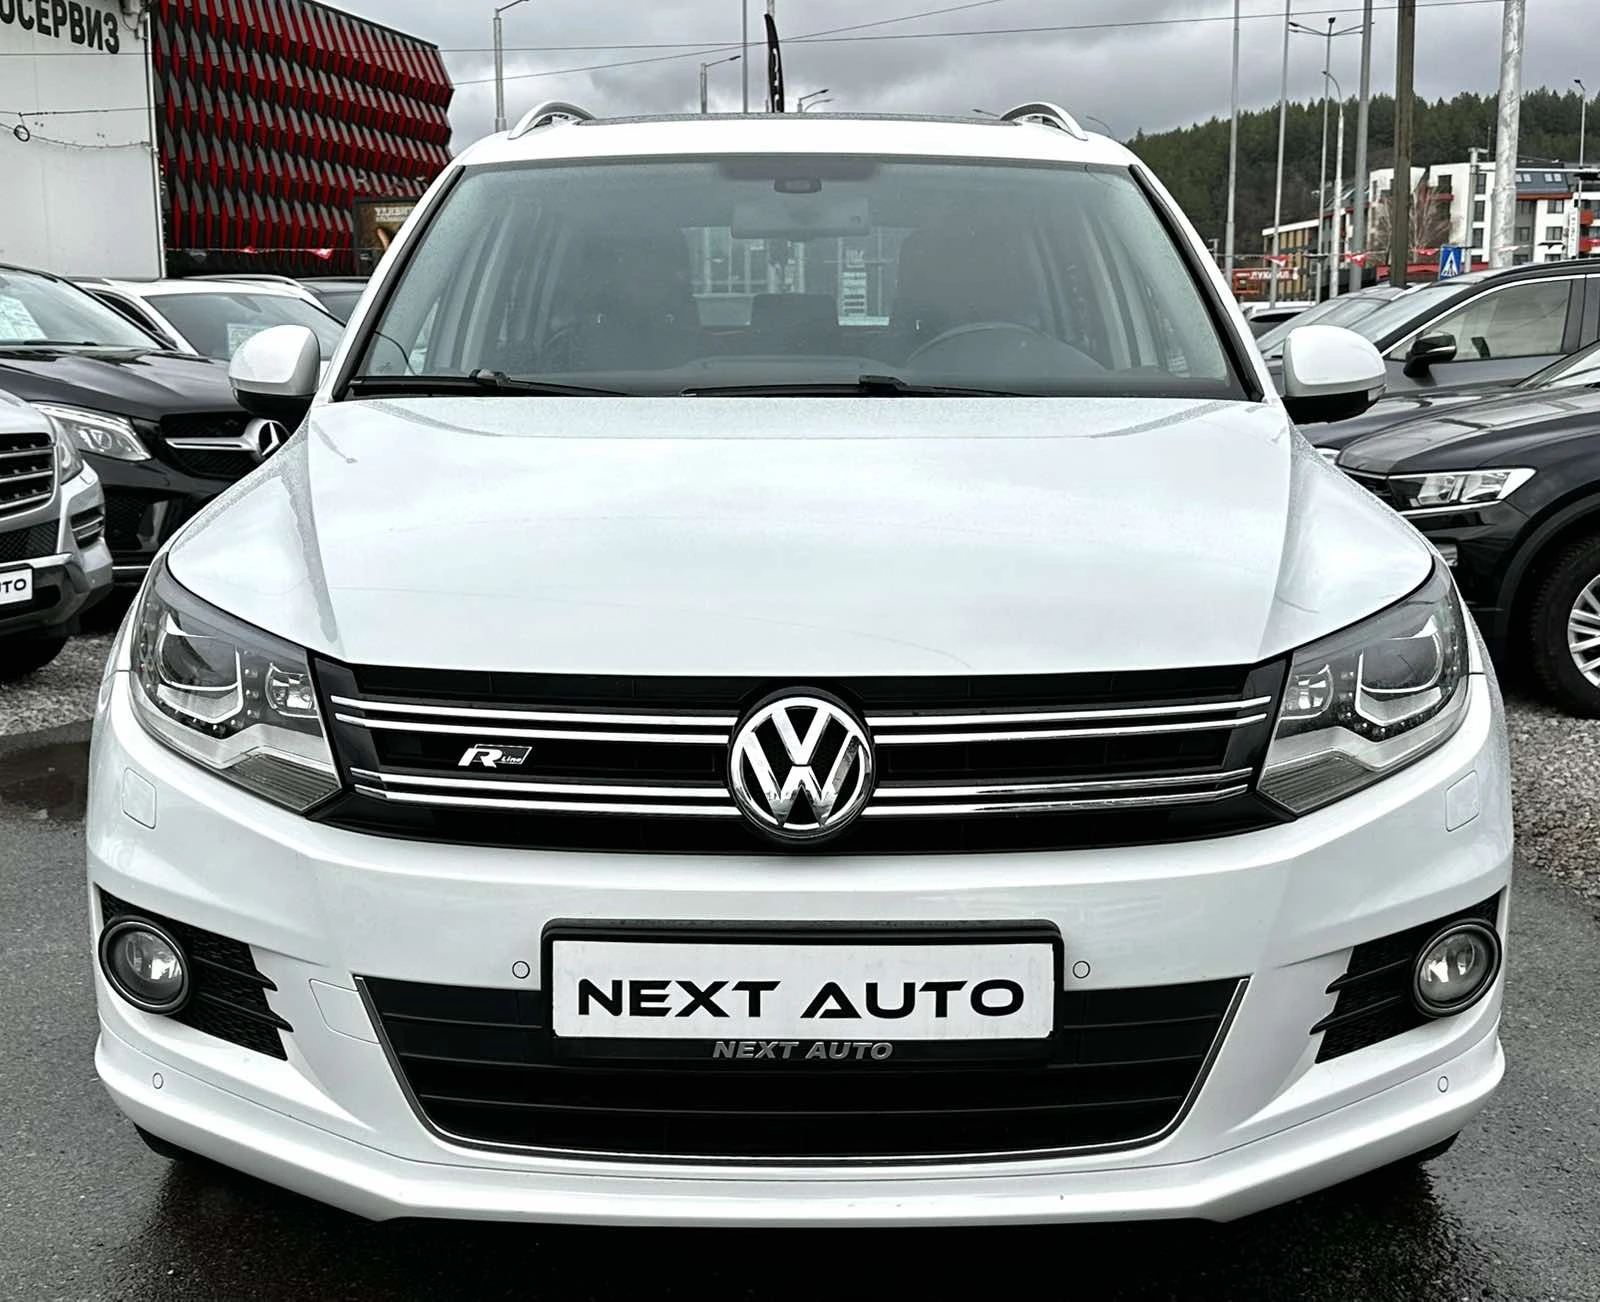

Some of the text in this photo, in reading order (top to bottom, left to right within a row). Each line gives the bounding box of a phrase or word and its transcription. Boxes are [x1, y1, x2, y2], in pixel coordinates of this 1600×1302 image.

[0, 578, 27, 593] TO
[578, 979, 1024, 1019] NEXT AUTO
[712, 1041, 893, 1060] NEXT AUTO
